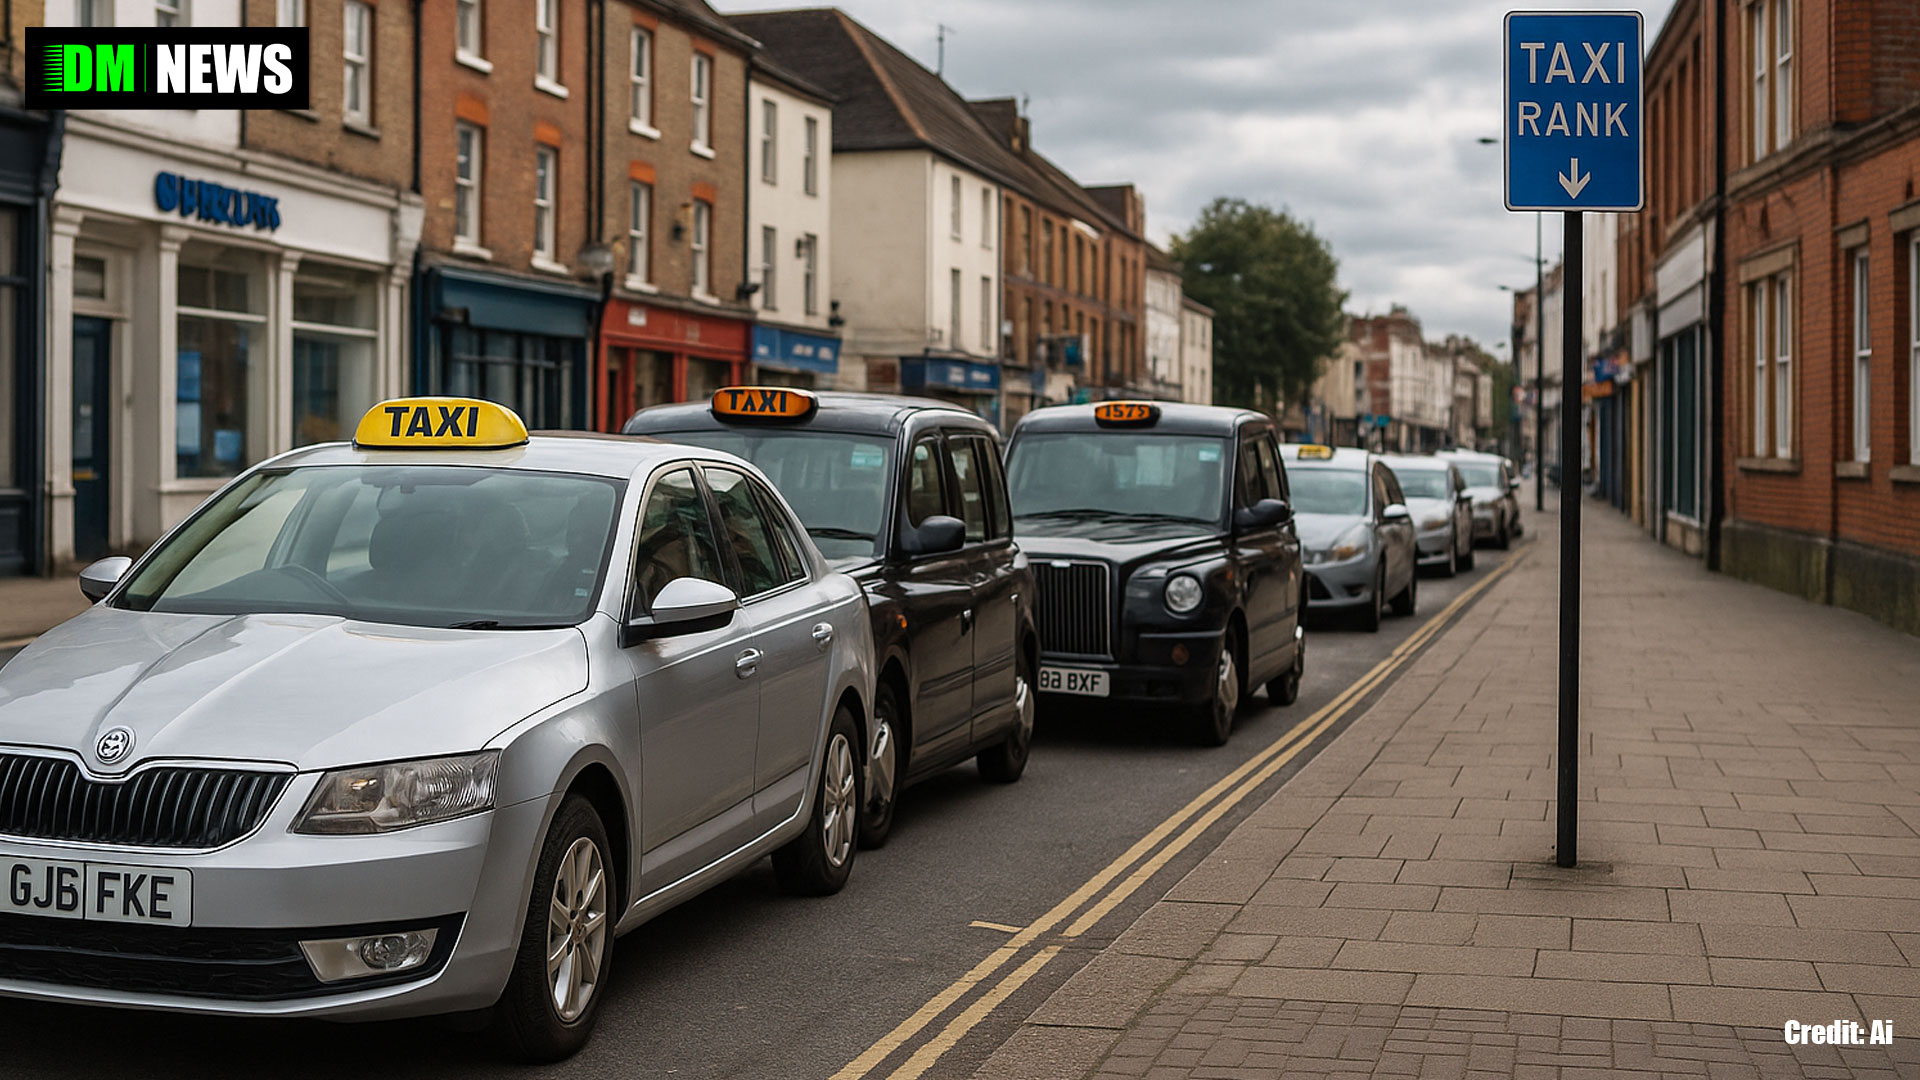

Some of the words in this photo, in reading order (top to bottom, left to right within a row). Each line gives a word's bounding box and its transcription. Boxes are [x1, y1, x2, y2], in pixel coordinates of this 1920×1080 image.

[1520, 42, 1625, 84] TAXI
[1518, 102, 1629, 137] RANK
[724, 390, 787, 413] TAXI
[384, 406, 479, 437] TAXI
[97, 871, 174, 919] FKE
